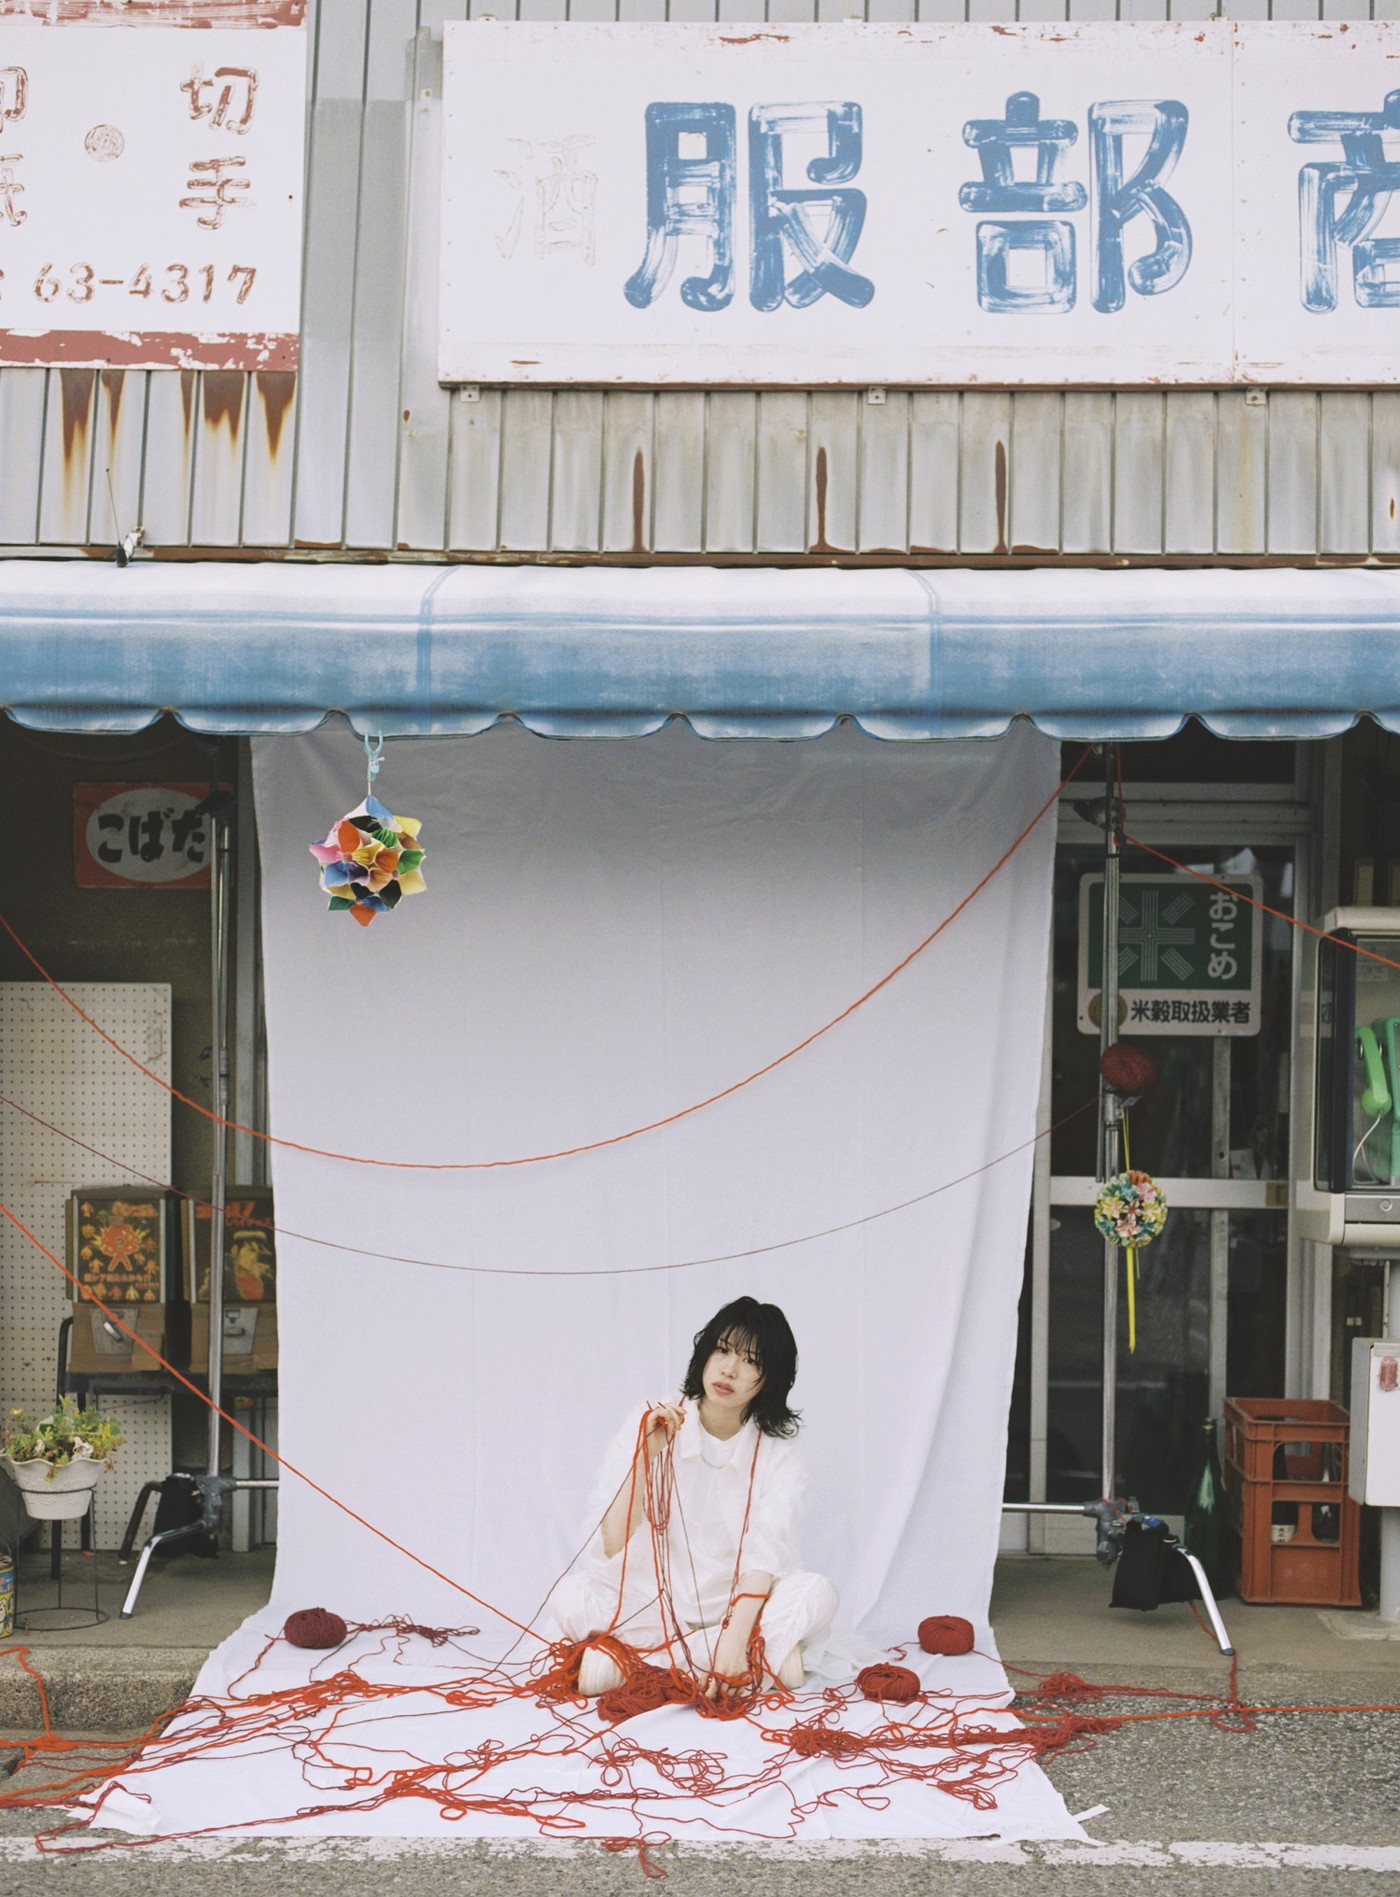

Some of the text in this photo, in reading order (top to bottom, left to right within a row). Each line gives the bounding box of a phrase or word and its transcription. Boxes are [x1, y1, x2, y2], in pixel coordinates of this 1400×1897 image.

[179, 61, 259, 231] 切手
[33, 262, 257, 305] 63-4317
[1207, 891, 1238, 980] おこめ
